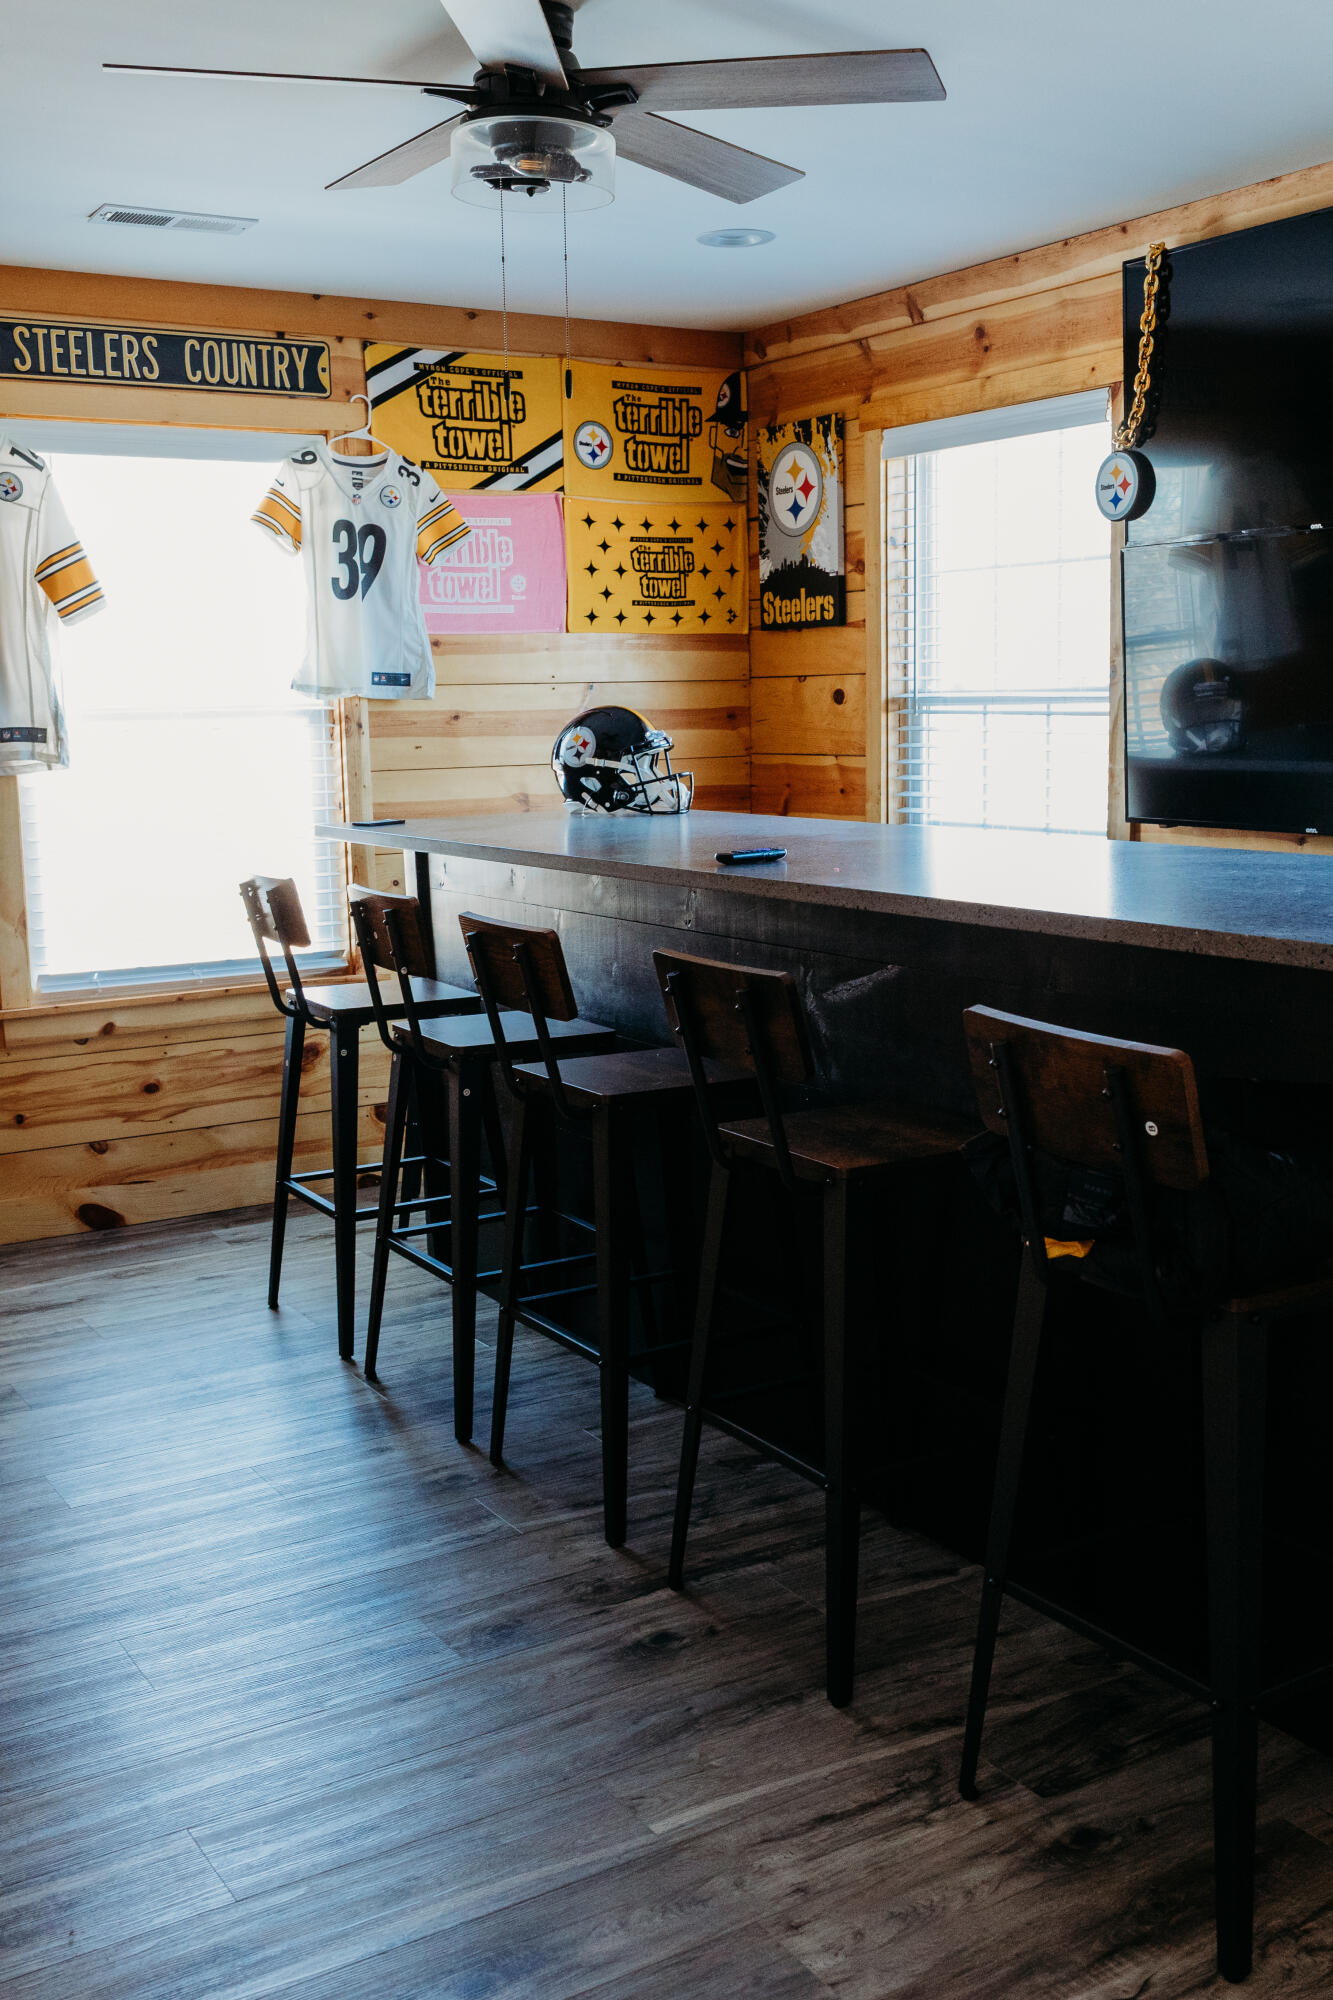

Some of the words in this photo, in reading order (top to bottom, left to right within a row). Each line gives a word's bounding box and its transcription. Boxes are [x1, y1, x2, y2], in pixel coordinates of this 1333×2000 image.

[13, 325, 160, 380] STEELERS
[184, 338, 309, 391] COUNTRY
[418, 363, 446, 372] MYRON
[449, 367, 479, 375] COPE'S
[481, 370, 518, 378] OFFICAL
[430, 376, 451, 385] The
[625, 394, 642, 402] The
[416, 378, 526, 424] terrible
[613, 396, 703, 437] terrible
[432, 420, 513, 462] towel
[624, 435, 690, 474] towel
[433, 463, 484, 471] PITTSBURGH
[487, 465, 525, 473] ORIGINAL
[775, 486, 794, 496] Steelers
[331, 519, 387, 602] 39
[630, 546, 695, 573] terrible
[427, 567, 500, 603] towel
[640, 573, 687, 599] towel
[763, 588, 835, 625] Steelers
